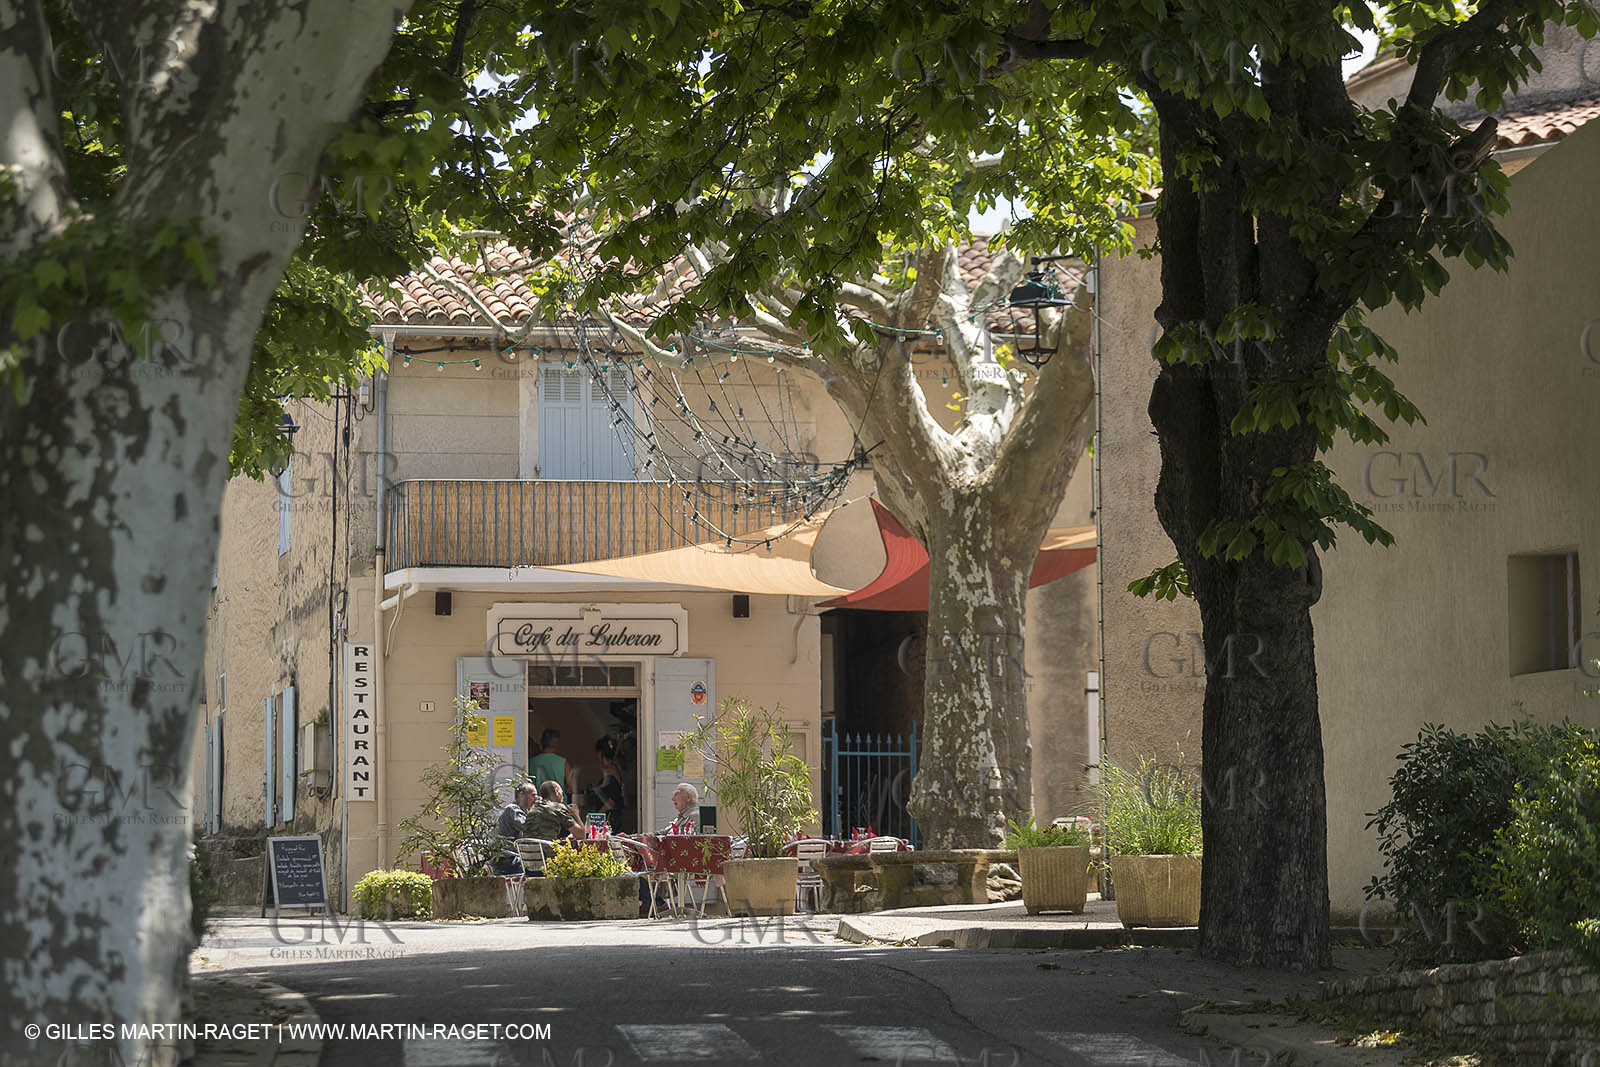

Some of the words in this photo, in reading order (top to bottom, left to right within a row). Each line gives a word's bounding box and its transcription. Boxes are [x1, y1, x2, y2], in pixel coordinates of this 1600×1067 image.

[514, 623, 553, 652] Café
[556, 626, 580, 647] du
[585, 623, 663, 647] Luberon
[353, 646, 370, 797] RESTAURANT
